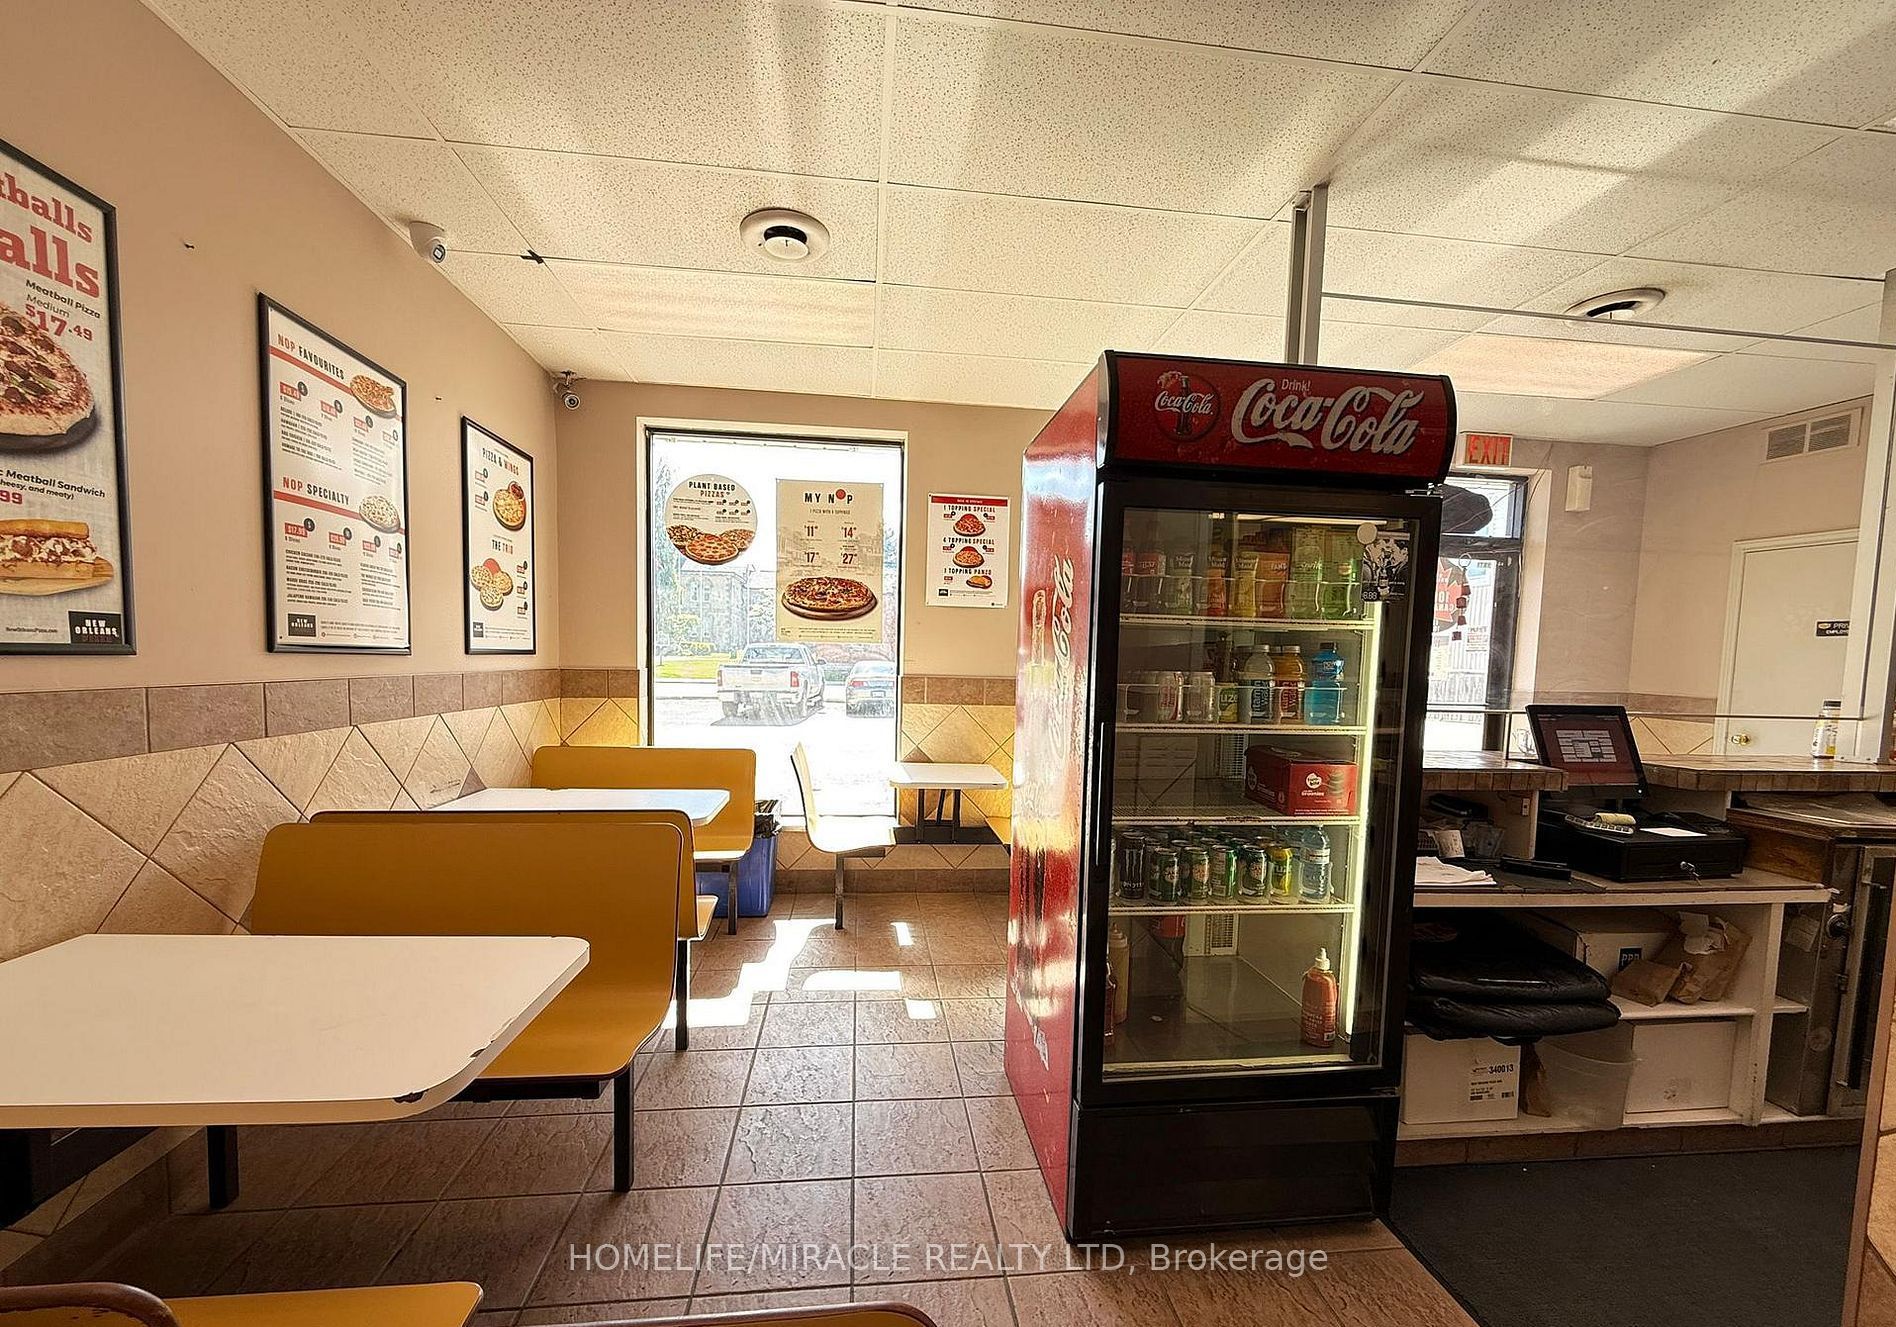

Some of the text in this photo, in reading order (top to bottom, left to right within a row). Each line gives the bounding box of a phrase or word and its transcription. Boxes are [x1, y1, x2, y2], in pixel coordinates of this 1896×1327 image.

[26, 279, 101, 319] Meatball Pizza
[26, 293, 70, 318] Medium
[25, 304, 93, 341] $17.49
[299, 345, 344, 380] FAVOURITES
[1281, 378, 1311, 392] Drink!
[1231, 378, 1424, 456] Coca-Cola
[1468, 435, 1510, 465] EXIT
[6, 469, 106, 498] Meatball Sandwich
[28, 484, 45, 494] and
[46, 489, 74, 500] meaty)
[282, 476, 350, 506] NOP SPECIALTY
[688, 481, 736, 491] PLANT BASED
[804, 492, 821, 503] MY
[74, 625, 118, 636] ORLEANS
[84, 619, 106, 627] NEW
[1488, 1064, 1514, 1074] 340013
